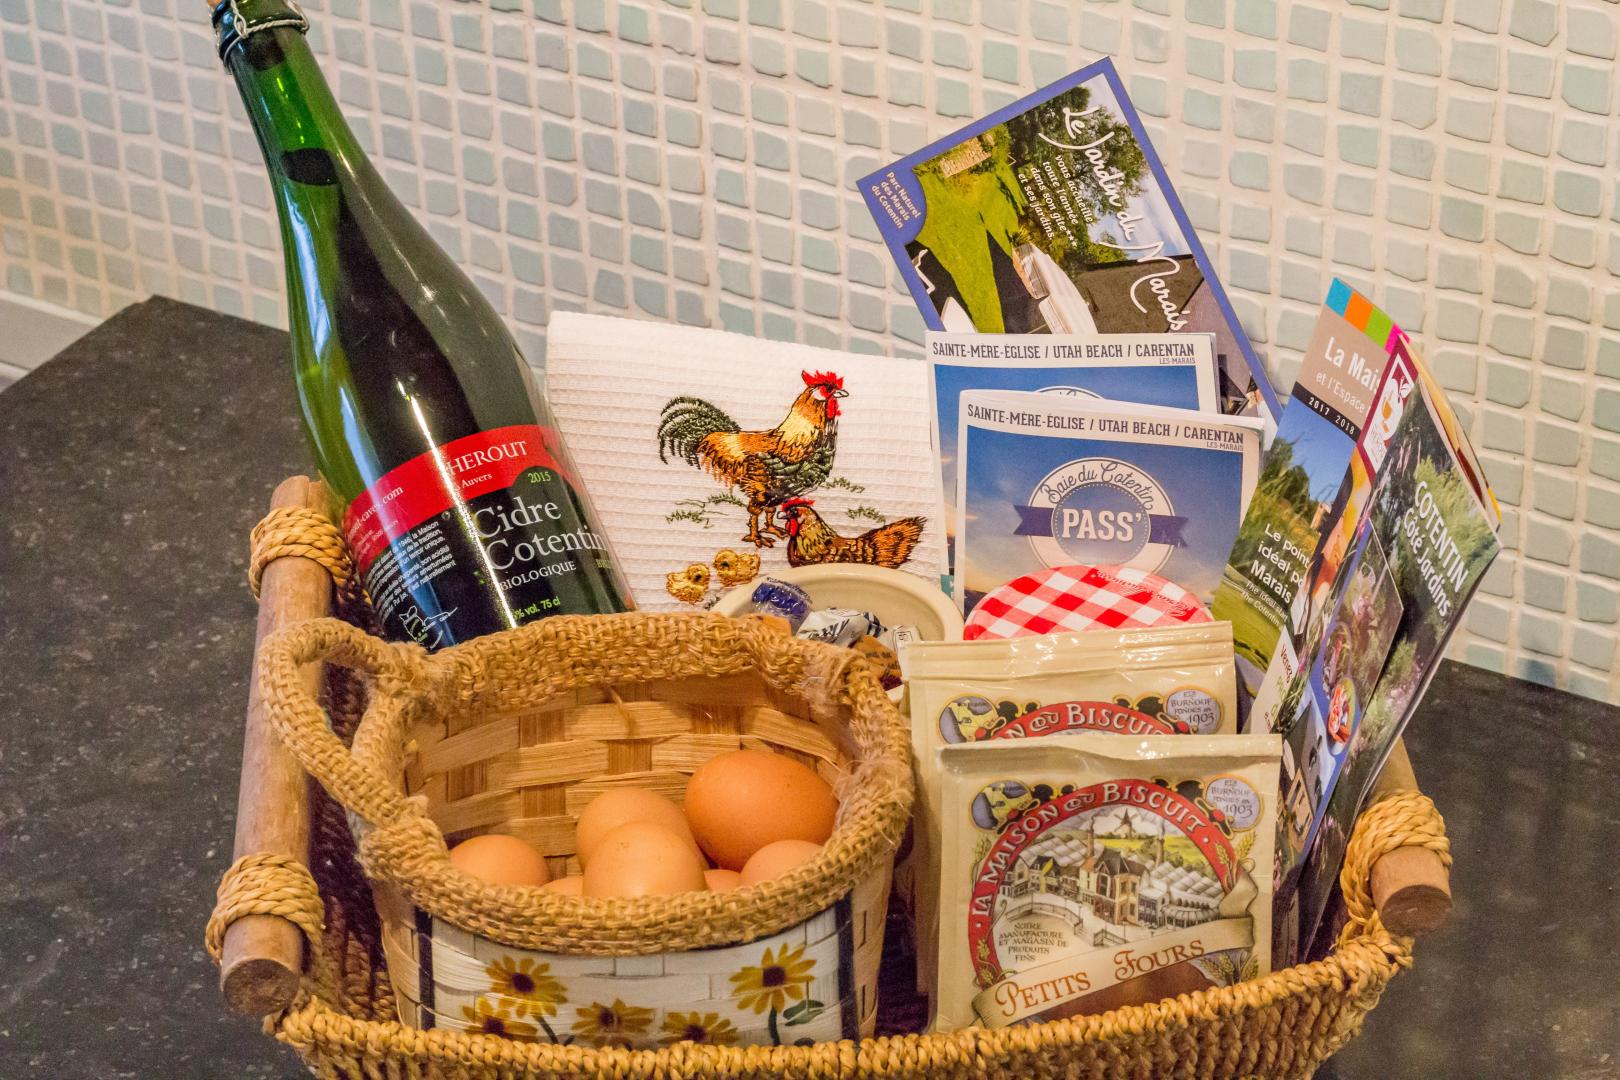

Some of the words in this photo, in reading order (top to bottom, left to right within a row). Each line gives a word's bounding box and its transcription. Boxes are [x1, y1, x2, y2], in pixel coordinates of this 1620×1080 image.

[1062, 105, 1100, 140] Le
[1018, 173, 1029, 184] et
[1030, 167, 1047, 191] dans
[1043, 192, 1057, 211] son
[1038, 131, 1126, 207] Jardin
[1055, 154, 1071, 179] vous
[1067, 180, 1093, 223] accueille
[871, 185, 881, 196] du
[879, 195, 904, 229] Cotentin
[881, 181, 893, 196] des
[890, 194, 910, 221] Marais
[886, 171, 901, 191] Parc
[898, 188, 922, 218] Naturel
[1024, 185, 1037, 202] ses
[1043, 161, 1060, 188] toute
[1056, 188, 1079, 225] l'année
[1029, 201, 1055, 240] jardins.
[1117, 210, 1144, 241] du
[1097, 240, 1191, 331] Marais
[932, 342, 1041, 359] SAINTE-MÈRE-ÉGLISE
[1053, 345, 1083, 359] UTAH
[1086, 344, 1123, 358] BEACH
[1135, 343, 1195, 357] CARENTAN
[1324, 336, 1345, 369] La
[1316, 372, 1328, 386] et
[1327, 377, 1366, 414] l'Espace
[967, 403, 1085, 430] SAINTE-MÈRE-ÉGLISE
[1098, 419, 1128, 434] UTAH
[1133, 421, 1171, 437] BEACH
[1183, 426, 1244, 444] CARENTAN
[1308, 396, 1330, 415] 2017
[1335, 415, 1355, 435] 2018
[447, 440, 528, 476] HEROUT
[527, 471, 552, 484] 2015
[461, 473, 493, 489] Auvers
[1040, 475, 1077, 505] Baie
[1078, 465, 1098, 483] du
[1100, 461, 1155, 511] Cotentin
[417, 521, 440, 536] Maison
[471, 495, 562, 539] Cidre
[1062, 508, 1142, 543] PASS'
[1414, 480, 1469, 593] COTENTIN
[485, 524, 609, 571] Cotentin
[1258, 540, 1291, 574] idéal
[1264, 523, 1281, 542] Le
[1282, 539, 1310, 569] point
[1404, 507, 1426, 555] Côté
[1417, 547, 1452, 617] Jardins
[500, 560, 577, 592] BIOLOGIQUE
[1250, 559, 1292, 604] Marais
[540, 598, 553, 610] 75
[552, 595, 561, 607] cl
[1102, 783, 1206, 834] BISCUIT
[980, 805, 1059, 884] MAISON
[971, 893, 993, 918] LA
[1012, 937, 1055, 945] MAGASIN
[1056, 939, 1067, 947] DE
[1015, 954, 1037, 963] FINS
[994, 971, 1091, 1018] PETITS
[1113, 939, 1206, 982] FOURS
